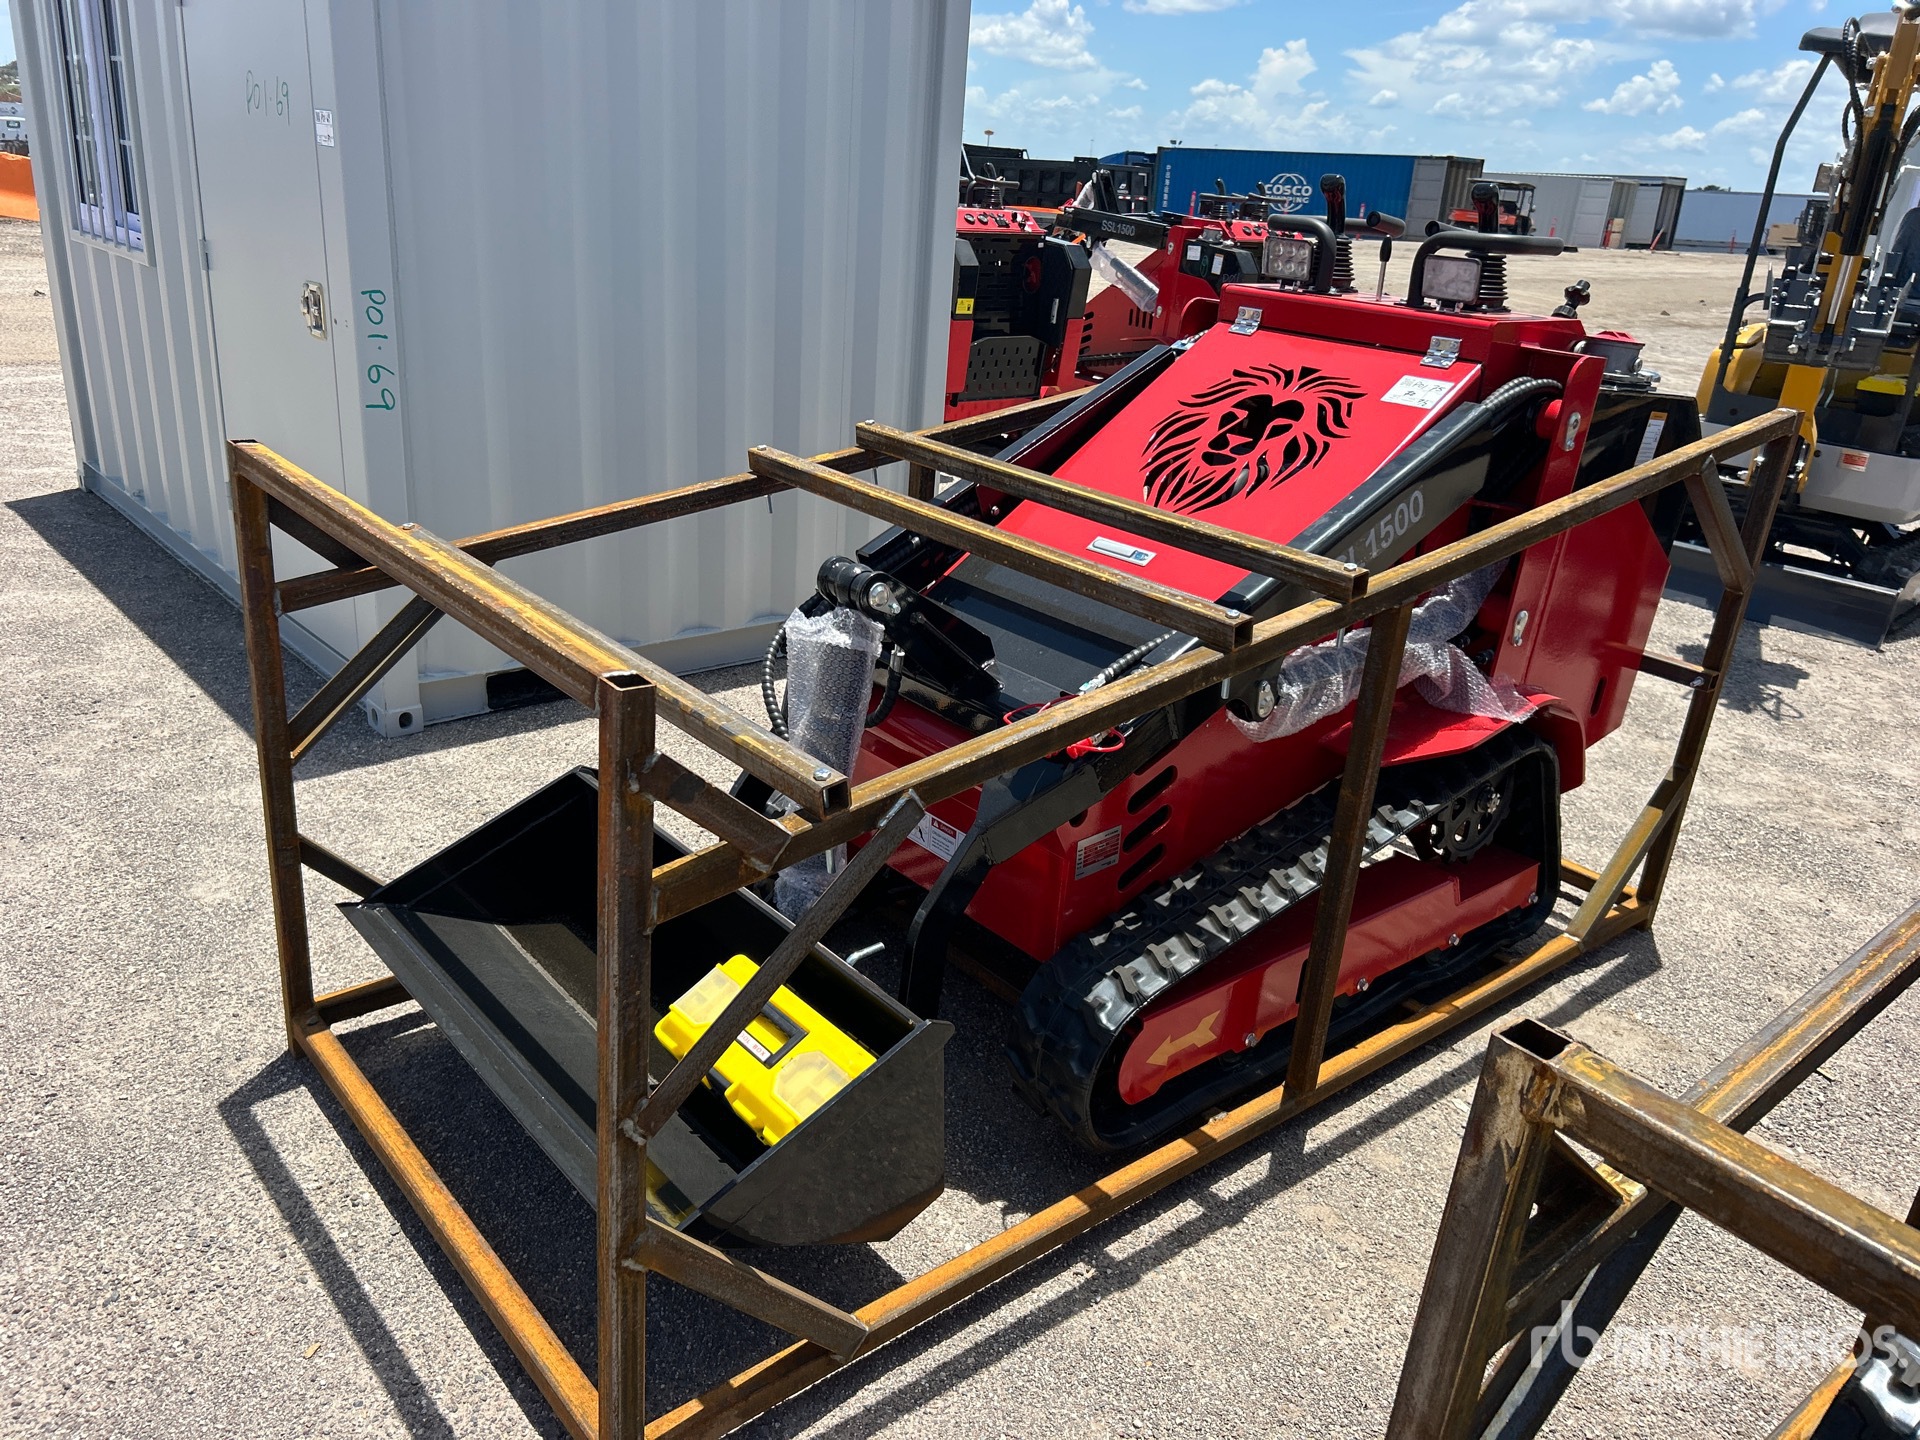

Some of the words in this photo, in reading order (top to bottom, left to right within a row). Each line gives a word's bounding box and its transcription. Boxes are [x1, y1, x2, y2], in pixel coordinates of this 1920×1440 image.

[1265, 184, 1313, 197] COSCO
[1101, 220, 1136, 236] SSL1500
[1365, 490, 1424, 560] 1500
[752, 1044, 766, 1057] BOX
